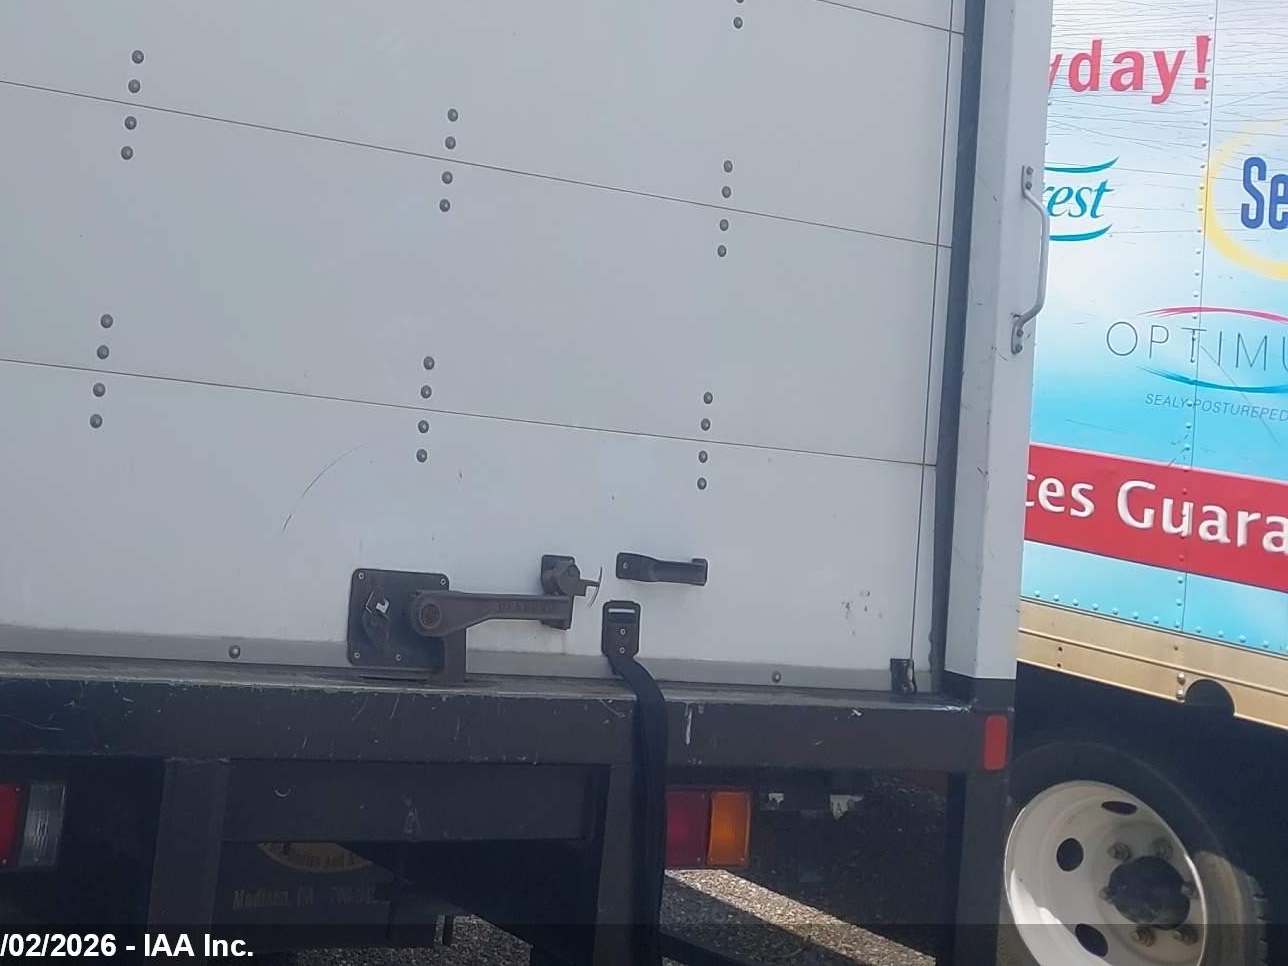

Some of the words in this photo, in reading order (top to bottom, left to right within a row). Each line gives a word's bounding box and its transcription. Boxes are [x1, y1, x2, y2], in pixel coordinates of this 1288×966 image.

[1106, 321, 1288, 371] OPTIM
[1145, 393, 1190, 410] SEALY
[1117, 480, 1288, 555] Guara
